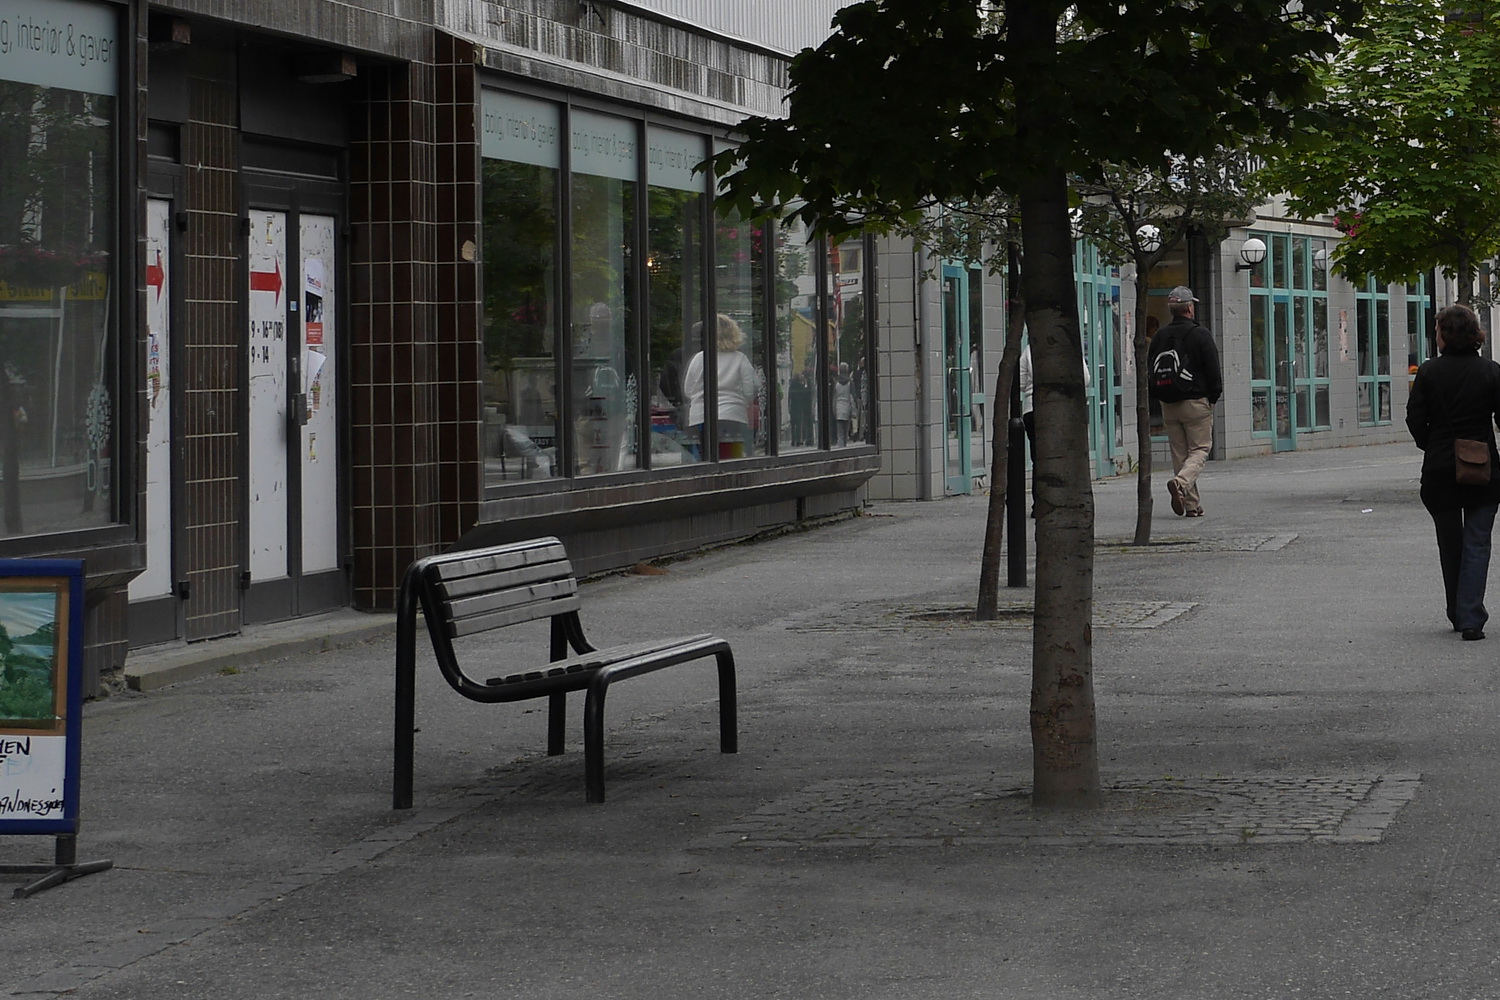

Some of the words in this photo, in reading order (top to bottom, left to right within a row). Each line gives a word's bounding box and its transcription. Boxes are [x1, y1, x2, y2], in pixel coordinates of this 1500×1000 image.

[17, 15, 63, 55] interiør
[66, 23, 76, 56] &
[79, 34, 114, 67] gaver
[262, 346, 269, 363] 14
